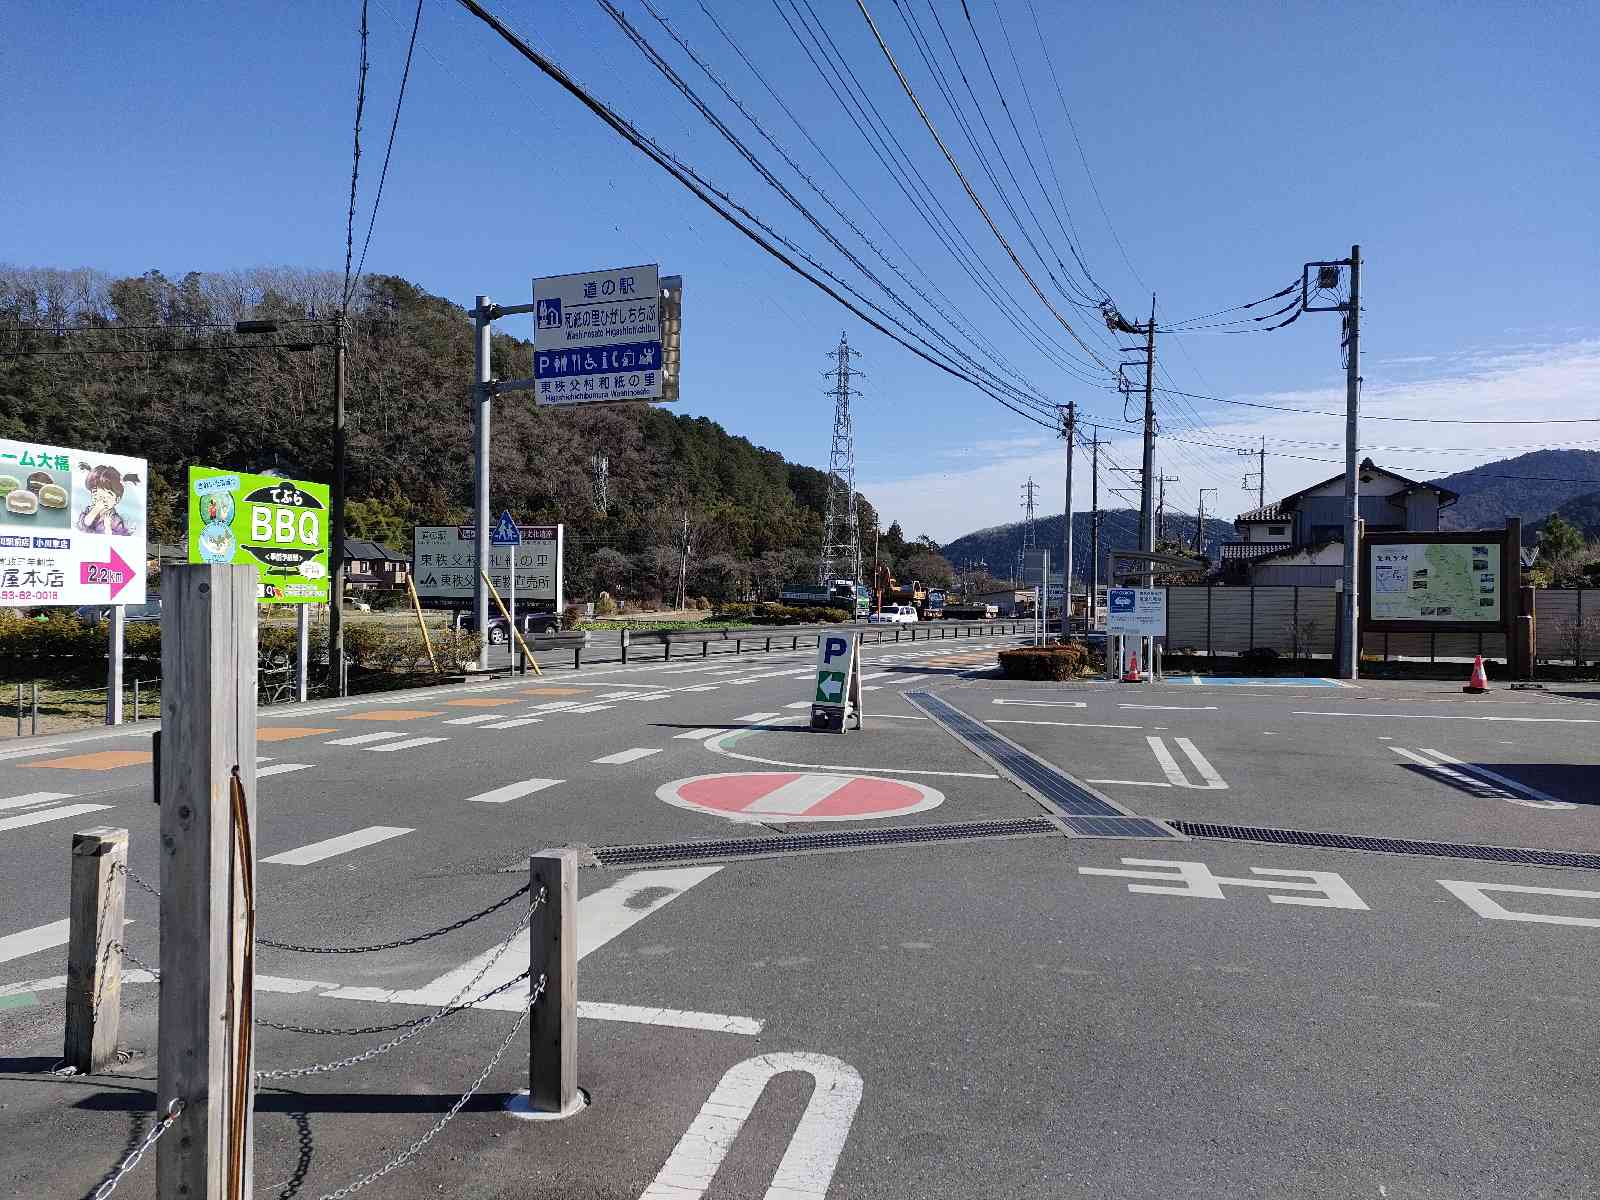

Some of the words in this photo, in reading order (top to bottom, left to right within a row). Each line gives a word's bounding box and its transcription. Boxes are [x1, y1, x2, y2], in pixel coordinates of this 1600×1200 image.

[583, 276, 635, 299] 道の駅
[564, 304, 657, 329] 和紙の里ひがしちちぶ
[540, 372, 657, 394] 東秩父村和紙の里
[270, 488, 303, 506] てぶら
[251, 505, 320, 546] BBQ
[0, 568, 65, 588] 屋本店
[88, 565, 124, 584] 2.2km
[0, 590, 59, 600] 93-82-0018
[823, 637, 848, 665] P
